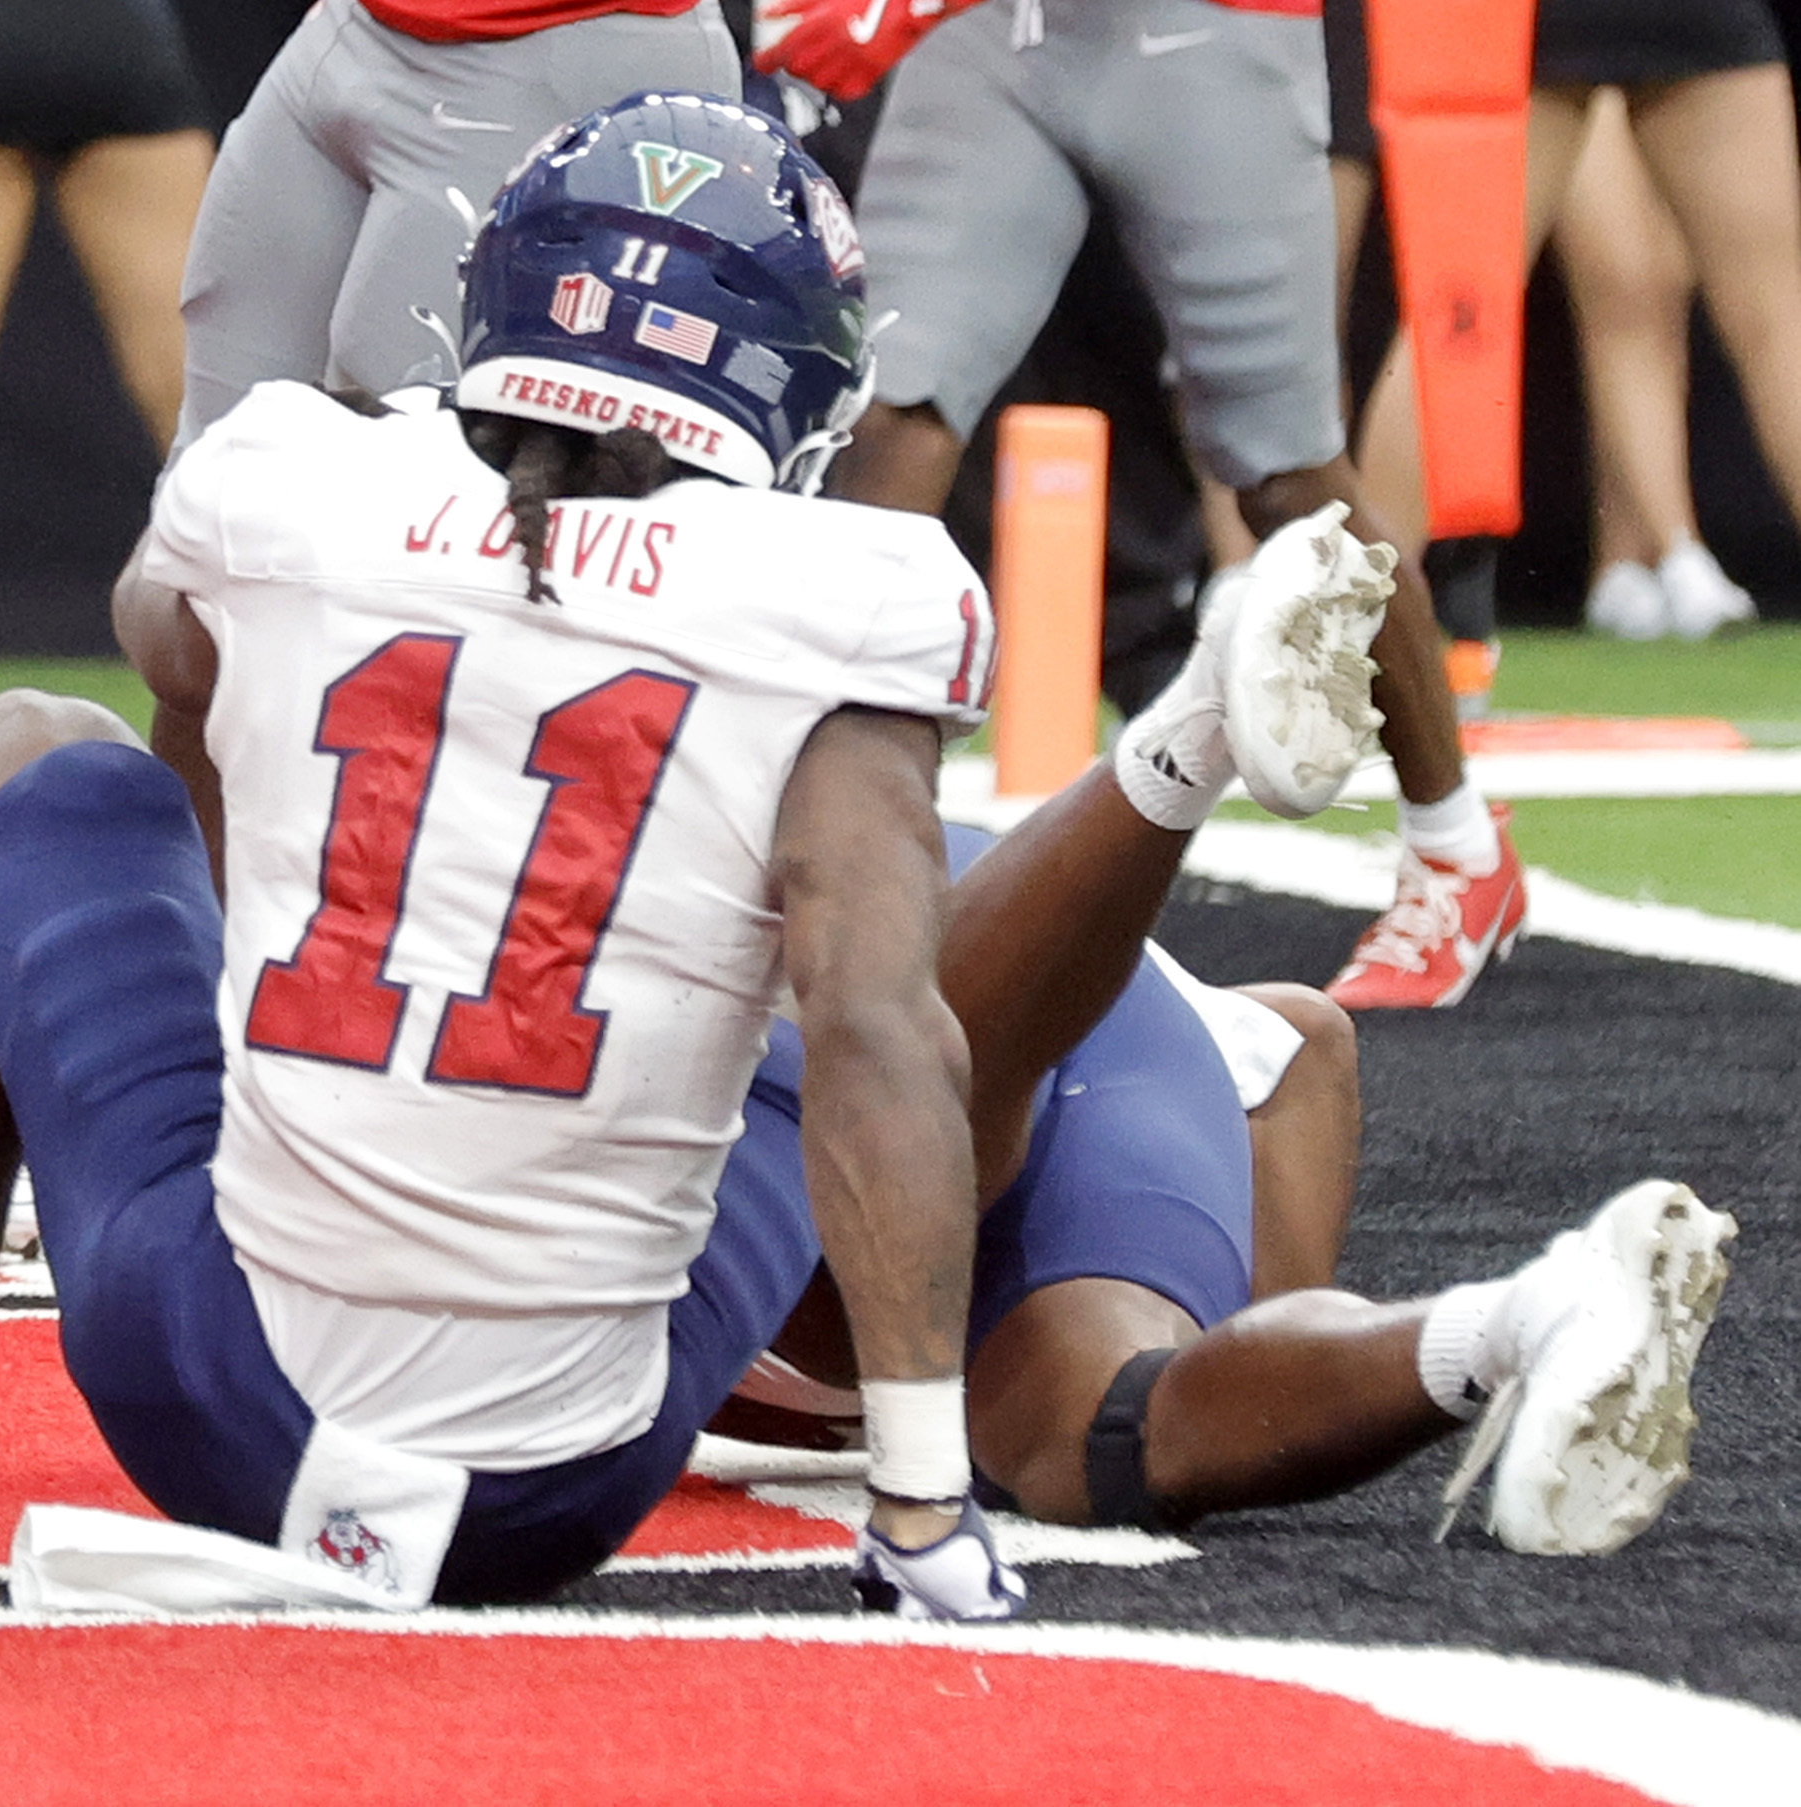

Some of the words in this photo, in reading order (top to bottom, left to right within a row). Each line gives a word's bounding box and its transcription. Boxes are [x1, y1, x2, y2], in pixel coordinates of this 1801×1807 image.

[610, 237, 670, 286] 11
[498, 372, 620, 423] FRESNO
[624, 404, 725, 456] STATE
[405, 494, 459, 555] J.
[245, 631, 699, 1097] 11
